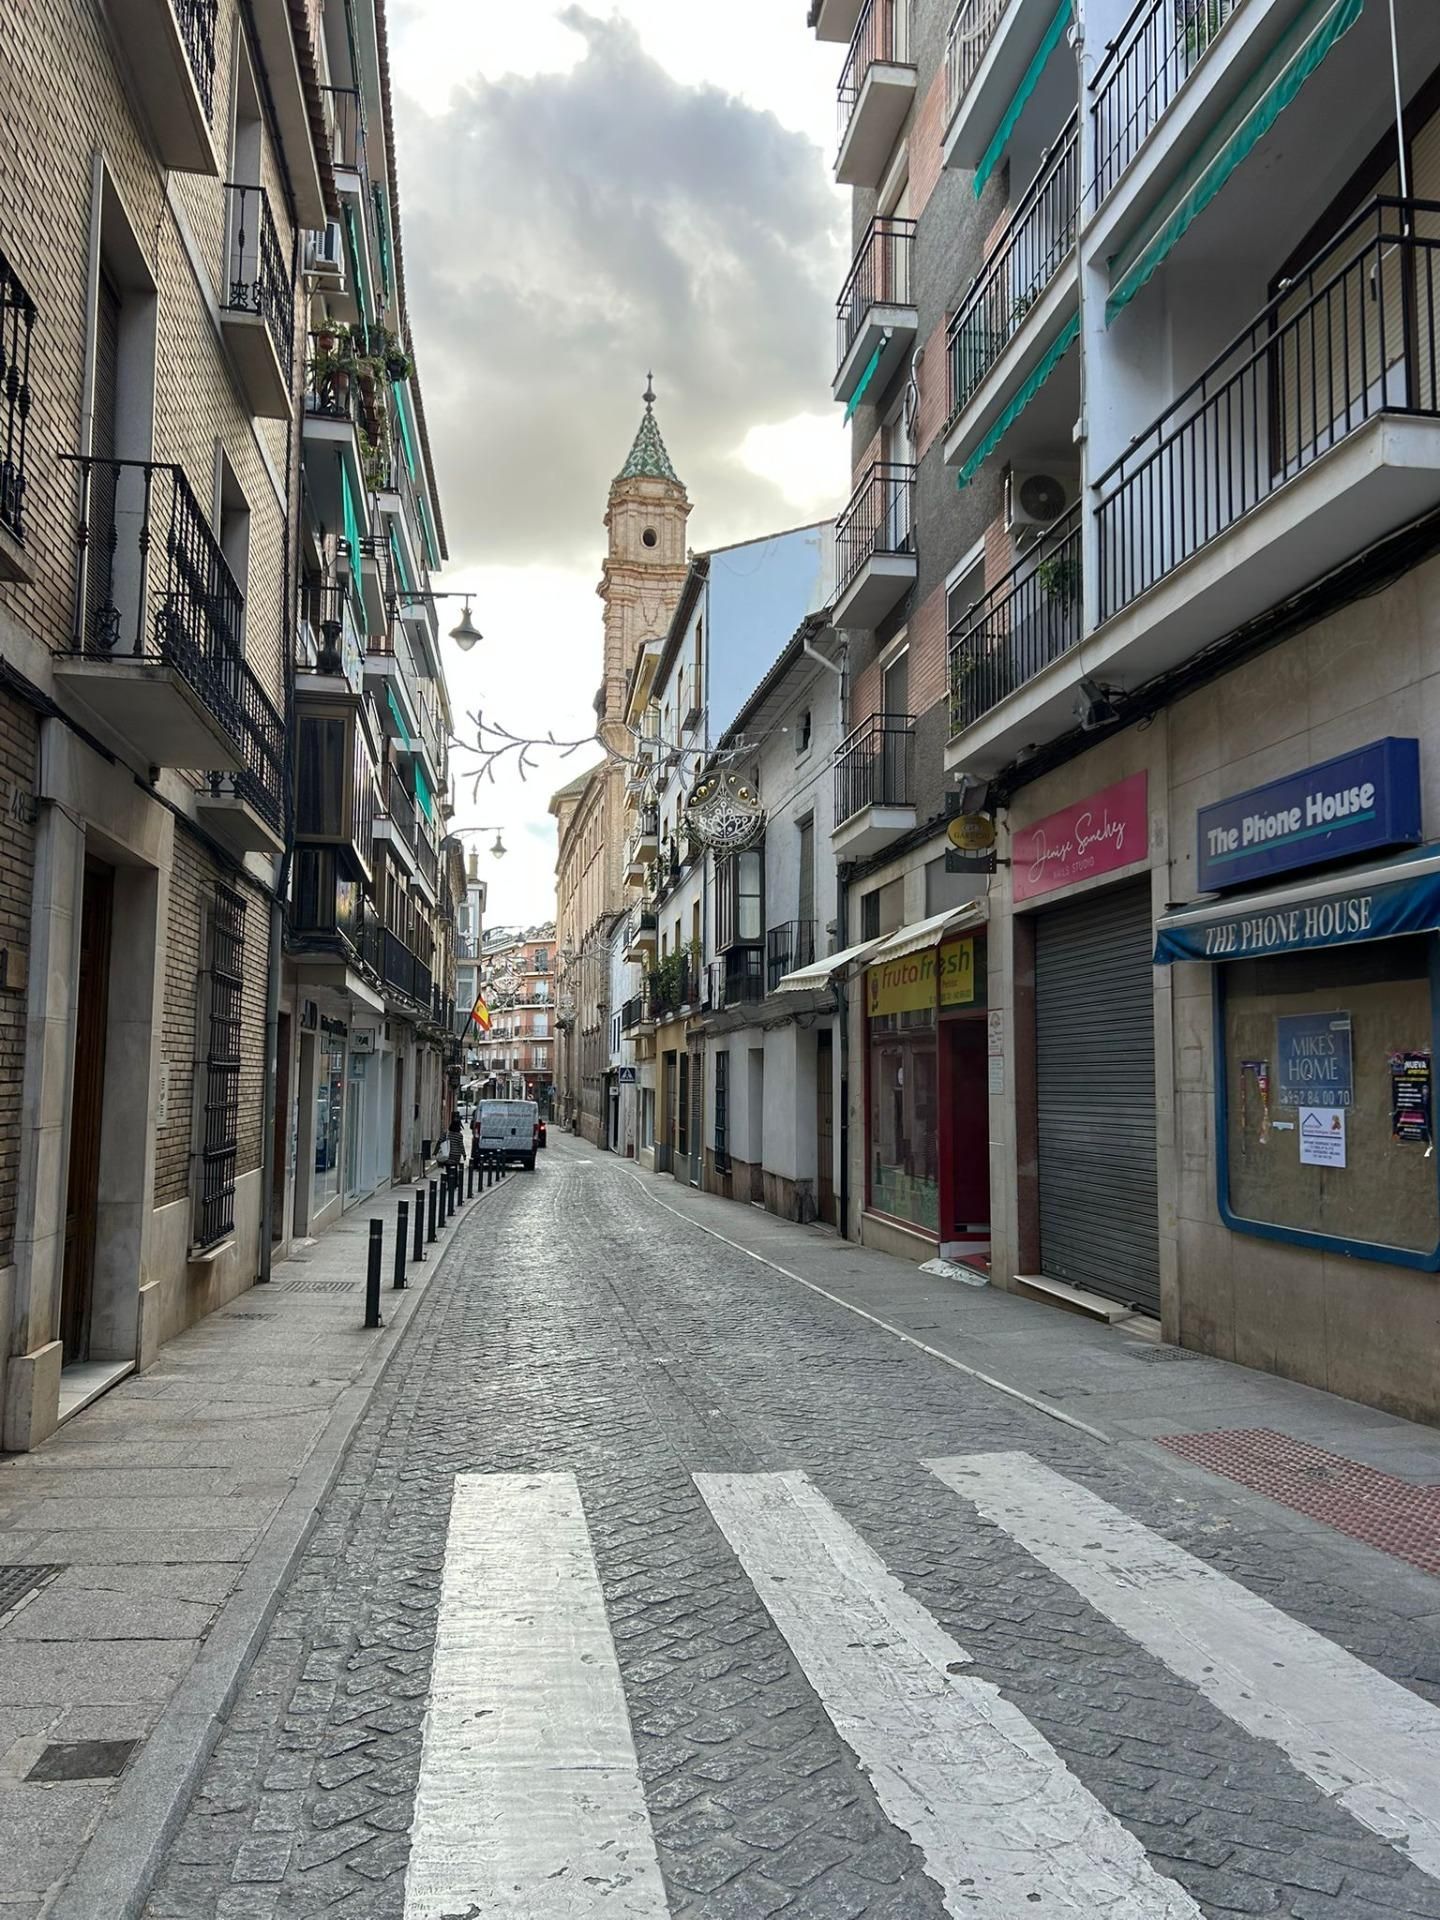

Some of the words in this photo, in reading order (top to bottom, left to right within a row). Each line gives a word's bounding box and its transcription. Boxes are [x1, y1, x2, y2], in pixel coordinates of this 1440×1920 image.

[1207, 826, 1239, 856] The
[1242, 807, 1302, 847] Phone
[1306, 782, 1375, 827] House
[1072, 856, 1096, 873] STUDIO
[1205, 923, 1237, 955] THE
[1241, 910, 1300, 949] PHONE
[1304, 896, 1373, 938] HOUSE
[1291, 1032, 1335, 1056] MIKE'S
[1288, 1057, 1339, 1081] HOME
[1287, 1090, 1305, 1105] 952
[1307, 1090, 1320, 1105] 84
[1322, 1090, 1335, 1105] 00
[1338, 1090, 1350, 1105] 70
